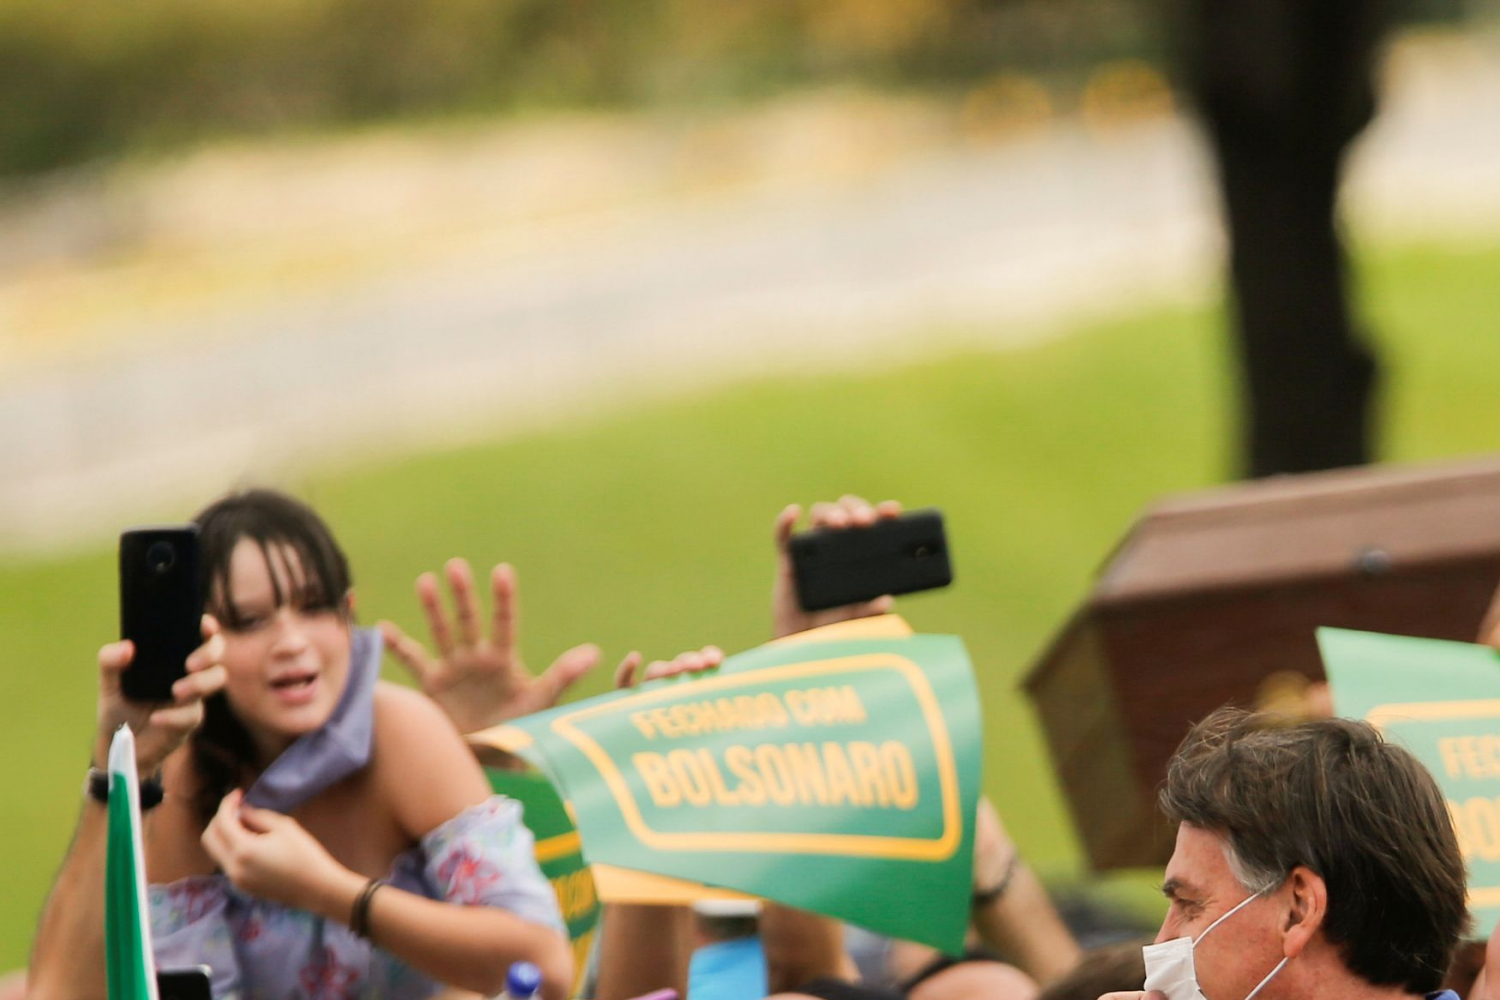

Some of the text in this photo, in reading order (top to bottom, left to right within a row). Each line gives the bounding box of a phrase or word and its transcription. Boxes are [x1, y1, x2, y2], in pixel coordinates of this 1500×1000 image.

[632, 686, 867, 738] FECHADO COM
[631, 741, 919, 809] BOLSONARO
